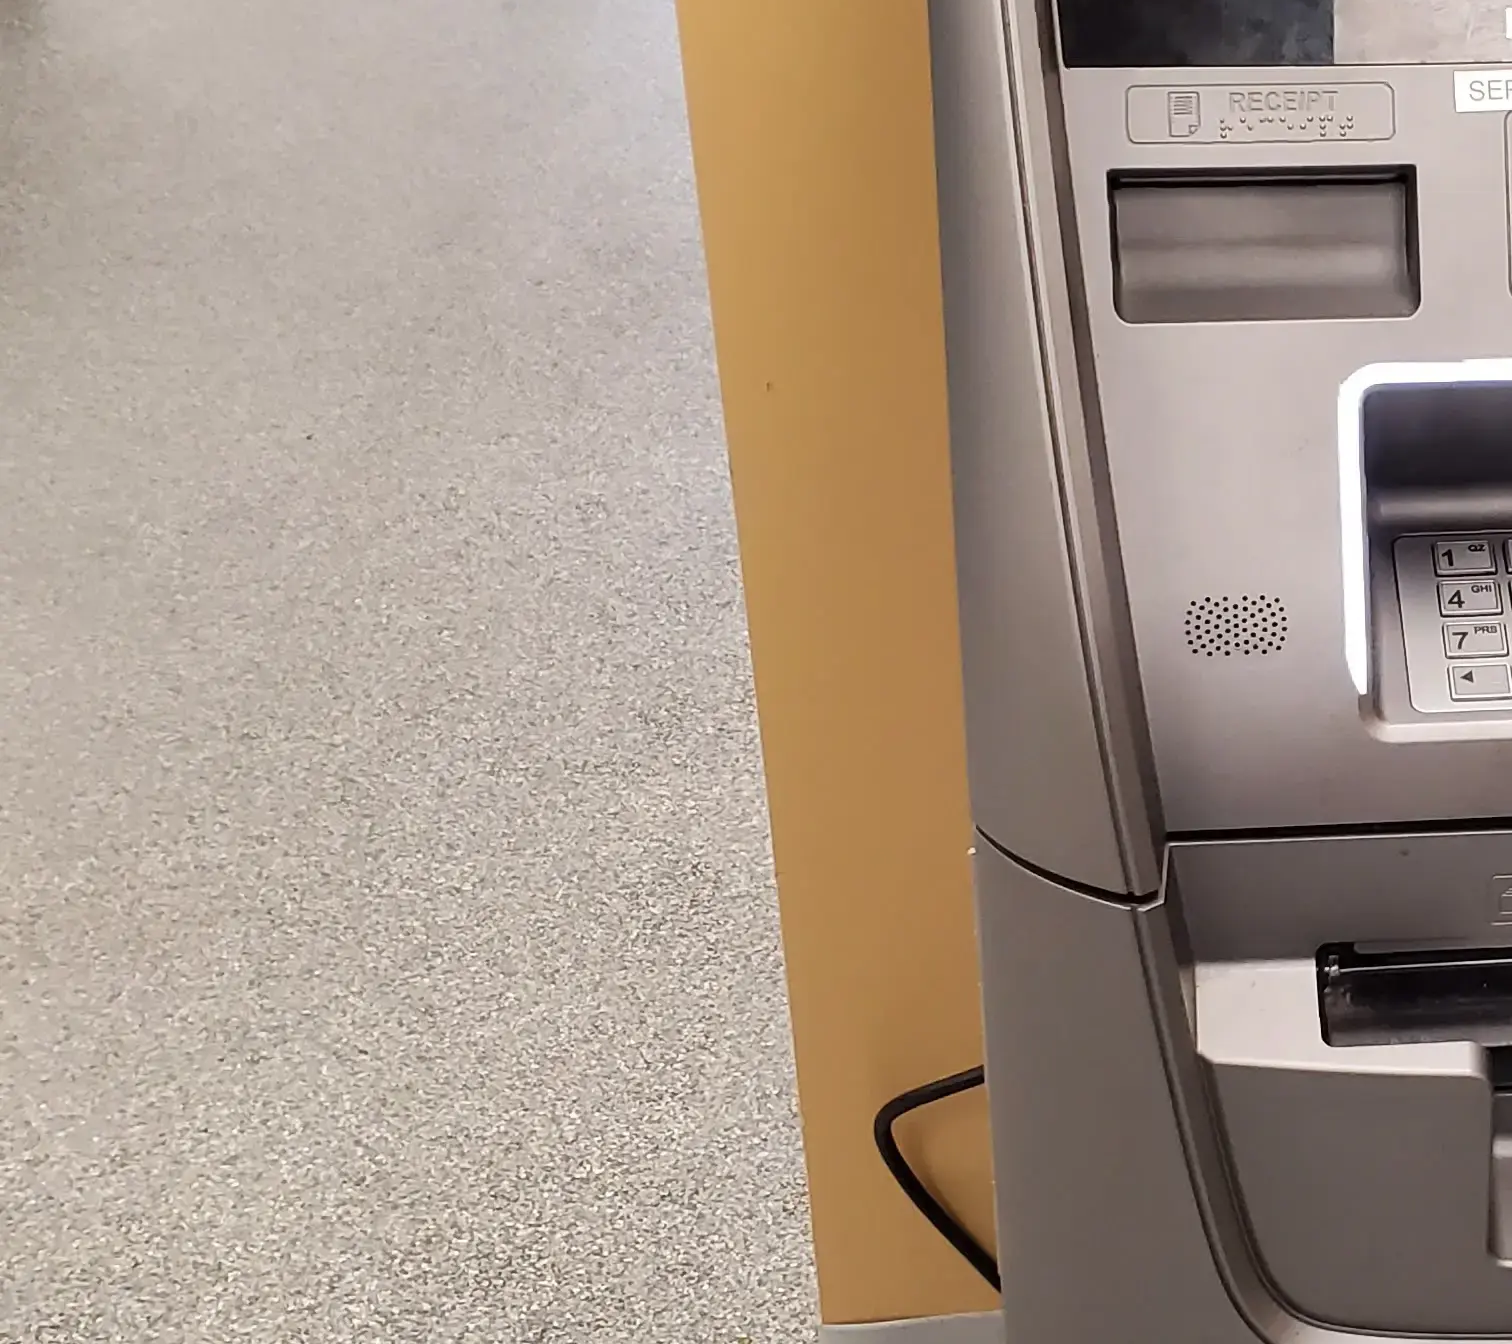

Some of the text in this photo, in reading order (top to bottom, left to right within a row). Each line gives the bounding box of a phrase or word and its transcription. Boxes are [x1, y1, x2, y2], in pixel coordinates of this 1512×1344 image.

[1229, 90, 1338, 111] RECEIPT
[1441, 544, 1486, 567] 1 QZ
[1447, 584, 1492, 608] 4 GHI
[1452, 625, 1498, 650] 7 PRS
